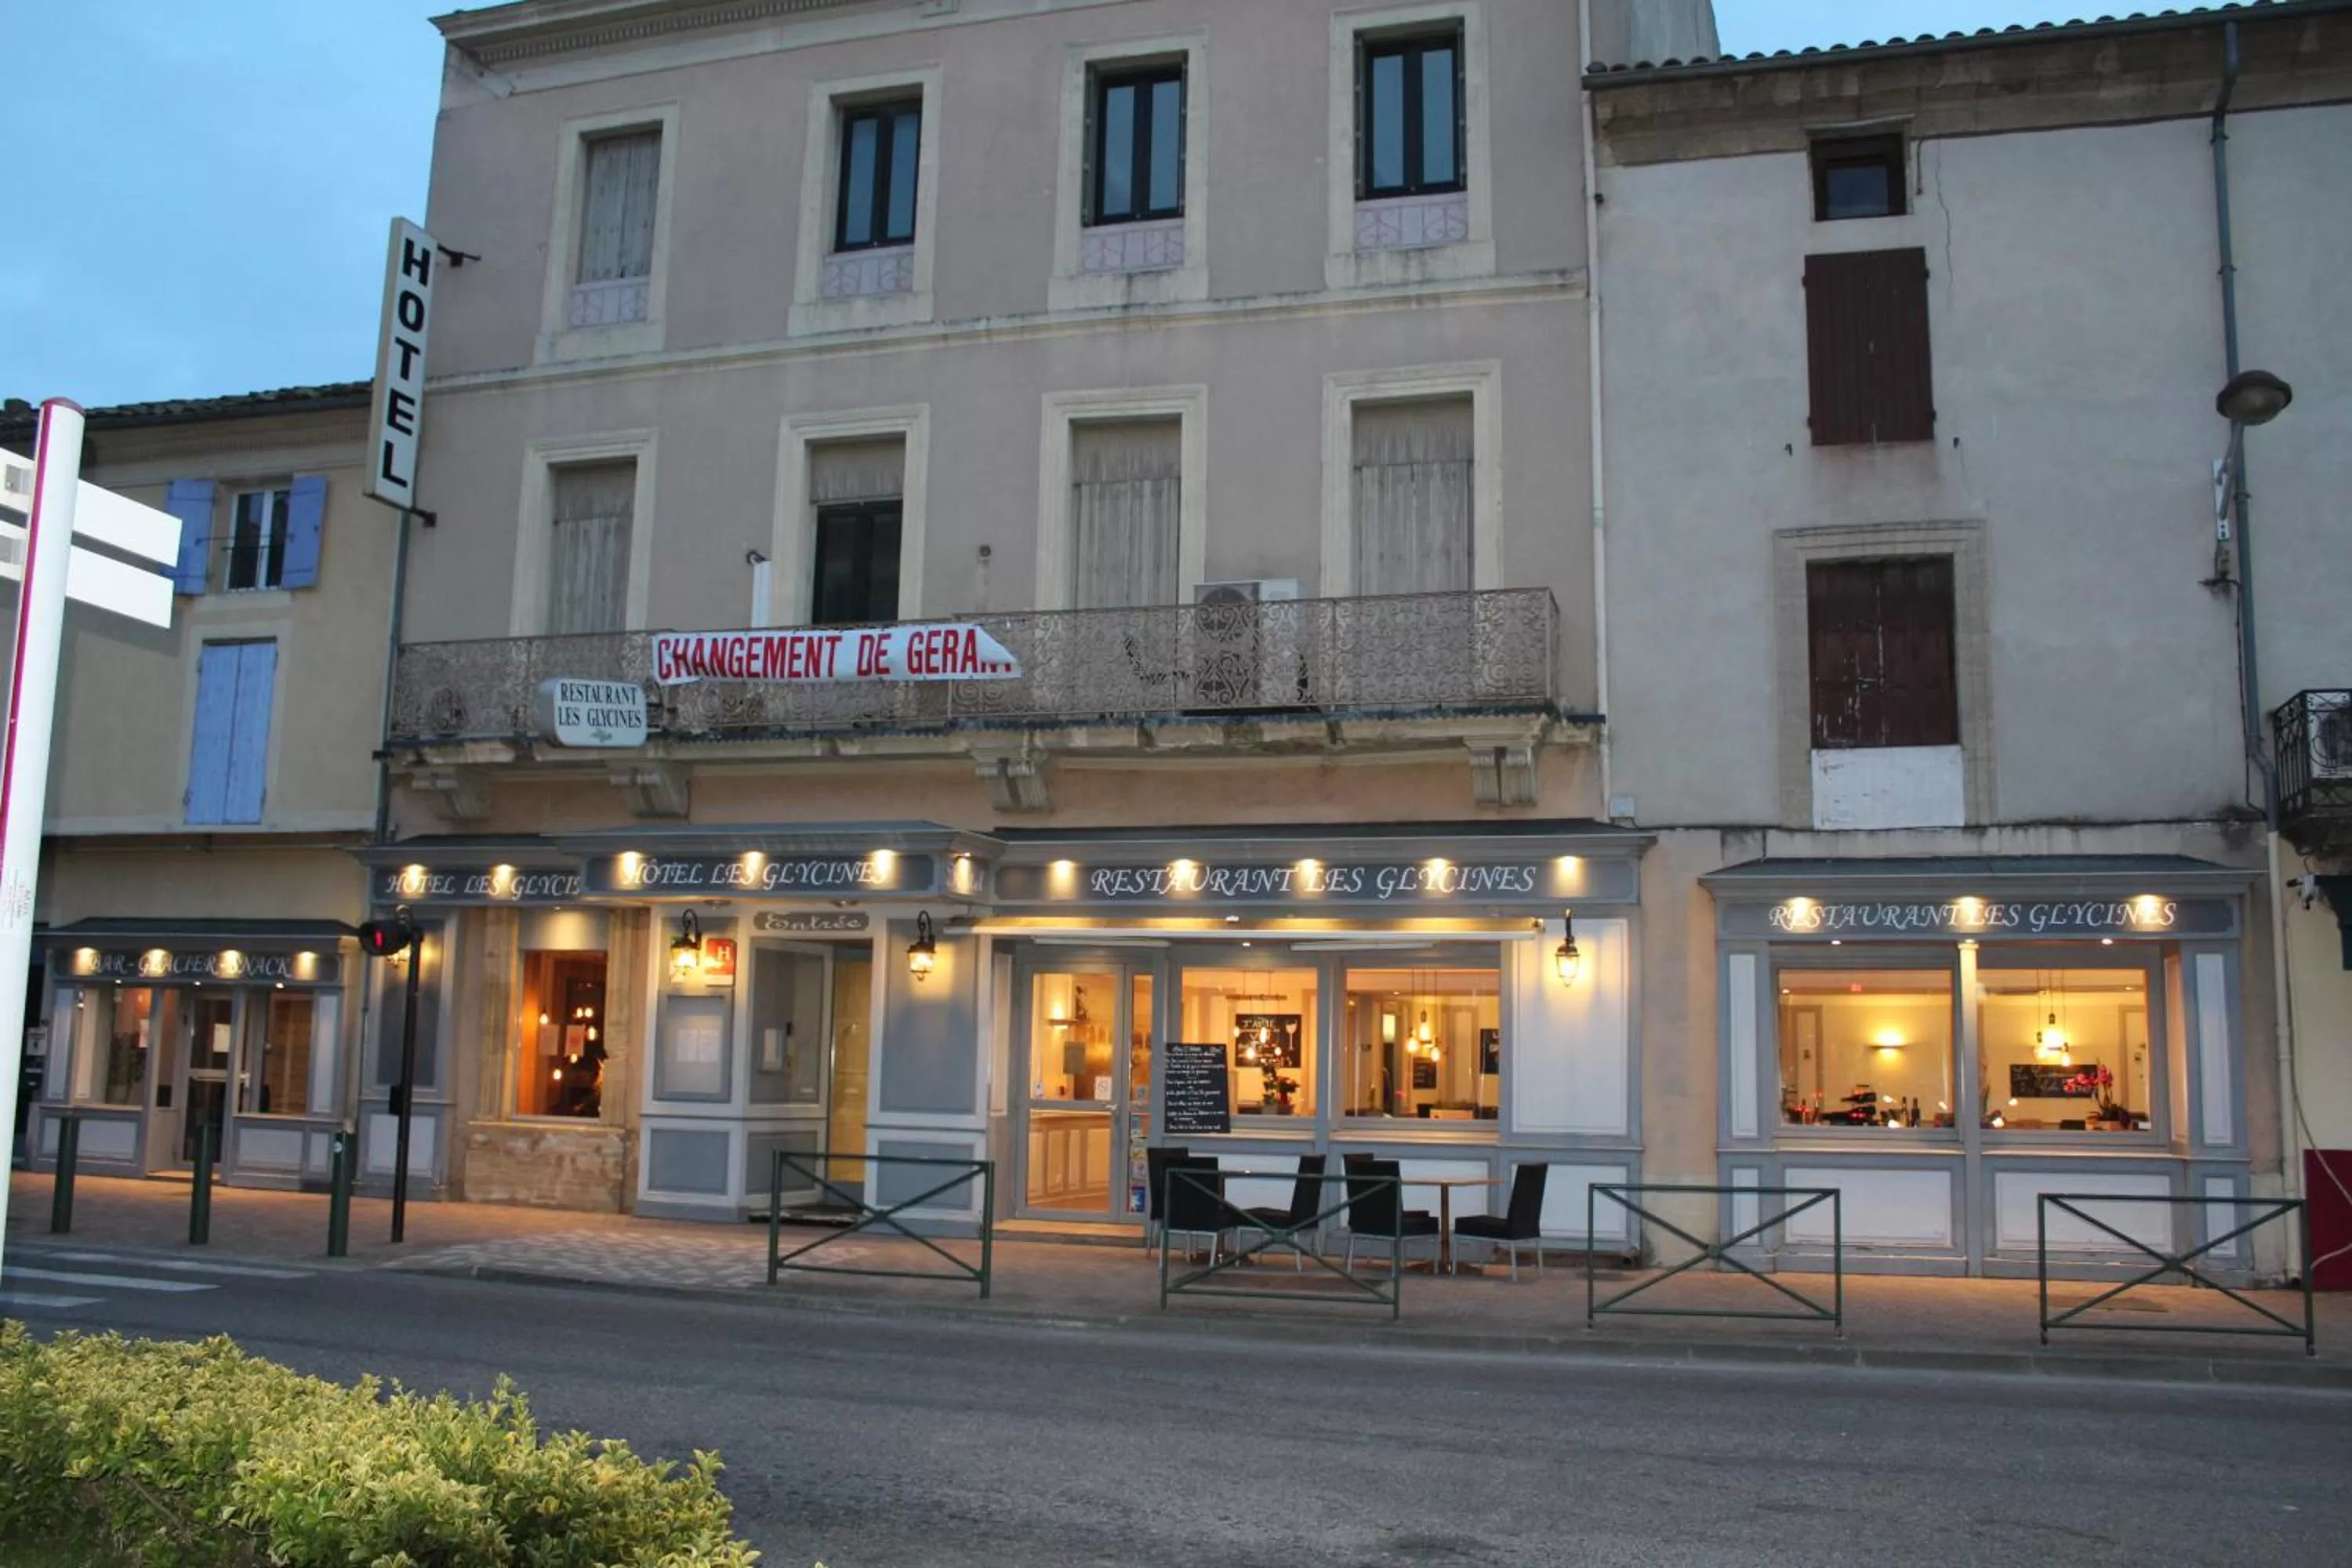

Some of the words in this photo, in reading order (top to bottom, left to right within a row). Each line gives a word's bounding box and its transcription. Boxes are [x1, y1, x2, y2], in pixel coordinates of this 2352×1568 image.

[382, 238, 430, 488] HOTEL
[657, 636, 843, 680] CHANGEMENT
[857, 633, 892, 677] DE
[560, 683, 638, 705] RESTAURANT
[557, 706, 580, 726] LES
[587, 708, 642, 728] GLYCINES
[463, 873, 503, 896] LES
[709, 862, 759, 886] LES
[761, 861, 891, 891] GLYCINES
[1091, 865, 1300, 896] RESTAURANT
[1304, 866, 1365, 894] LES
[1376, 864, 1537, 898] GLYCINES
[1768, 902, 1963, 931] RESTAURANT
[1966, 902, 2022, 927] LES
[2029, 901, 2178, 931] GLYCINES
